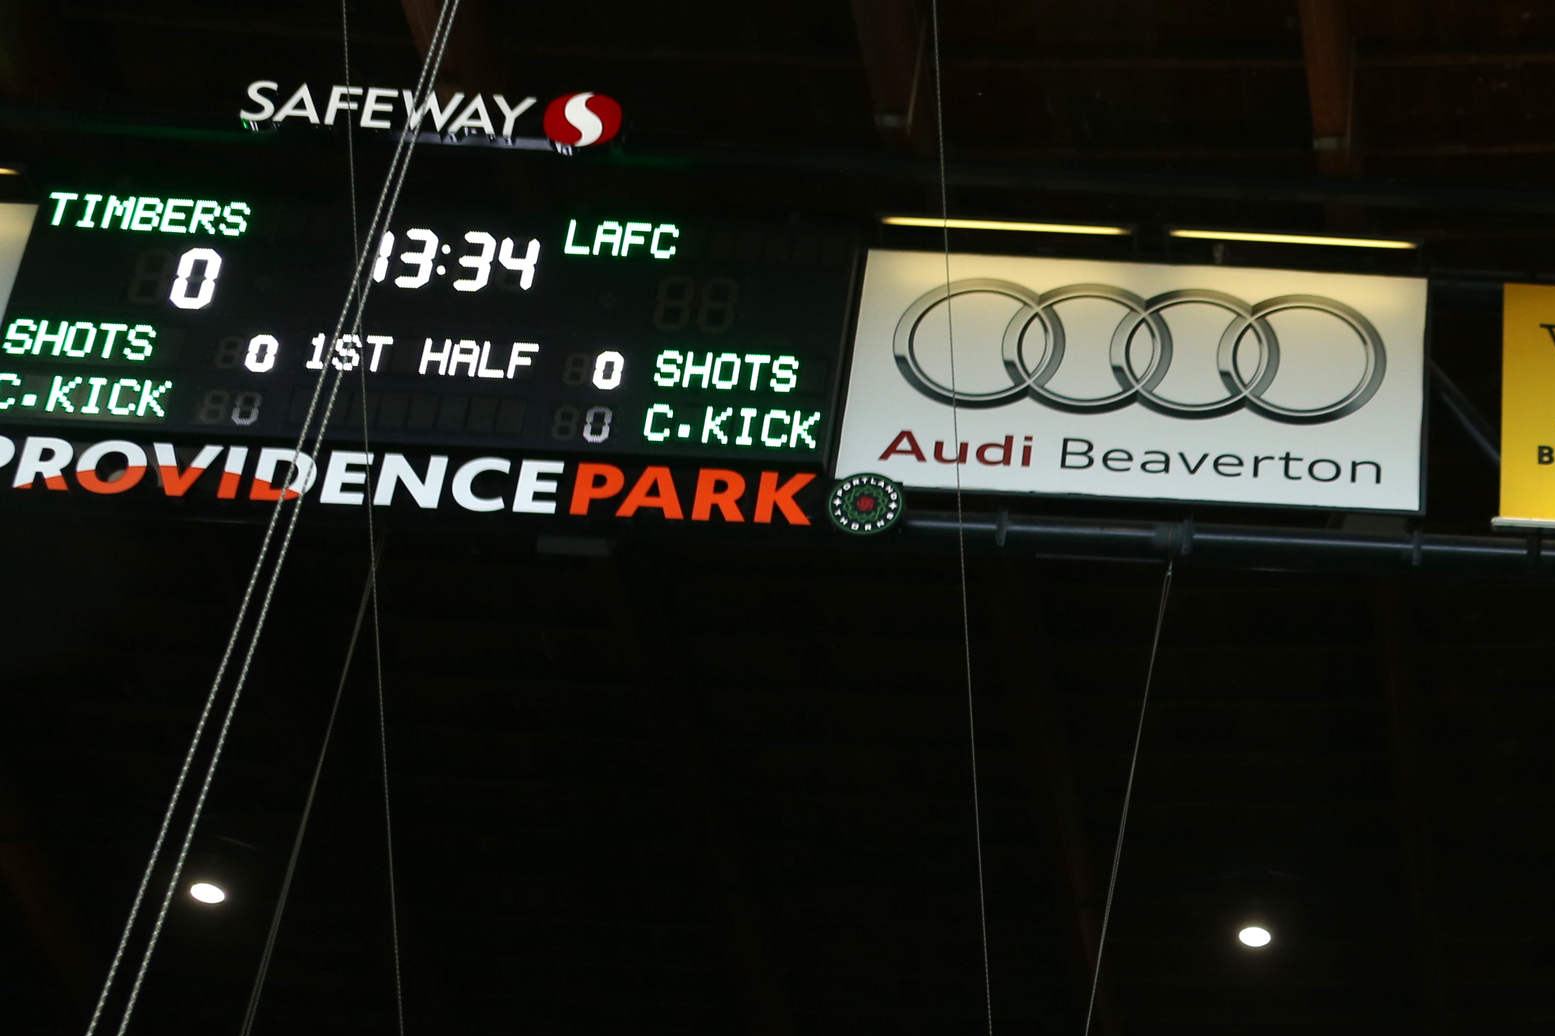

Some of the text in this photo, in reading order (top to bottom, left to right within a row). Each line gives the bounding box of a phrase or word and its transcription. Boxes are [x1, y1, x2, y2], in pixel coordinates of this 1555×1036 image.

[240, 80, 537, 137] SAFEWAY
[49, 191, 251, 237] TIMBERS
[563, 218, 680, 260] LAFC
[168, 247, 223, 310] 0
[373, 228, 541, 291] 13:34
[2, 318, 279, 373] SHOTS 0
[305, 332, 540, 379] 1ST HALF
[592, 349, 800, 393] 0 SHOTS
[643, 403, 821, 449] C.KICK
[879, 430, 1383, 485] Audi Beaverton
[569, 463, 817, 525] PARK
[836, 476, 898, 501] PORTLAND
